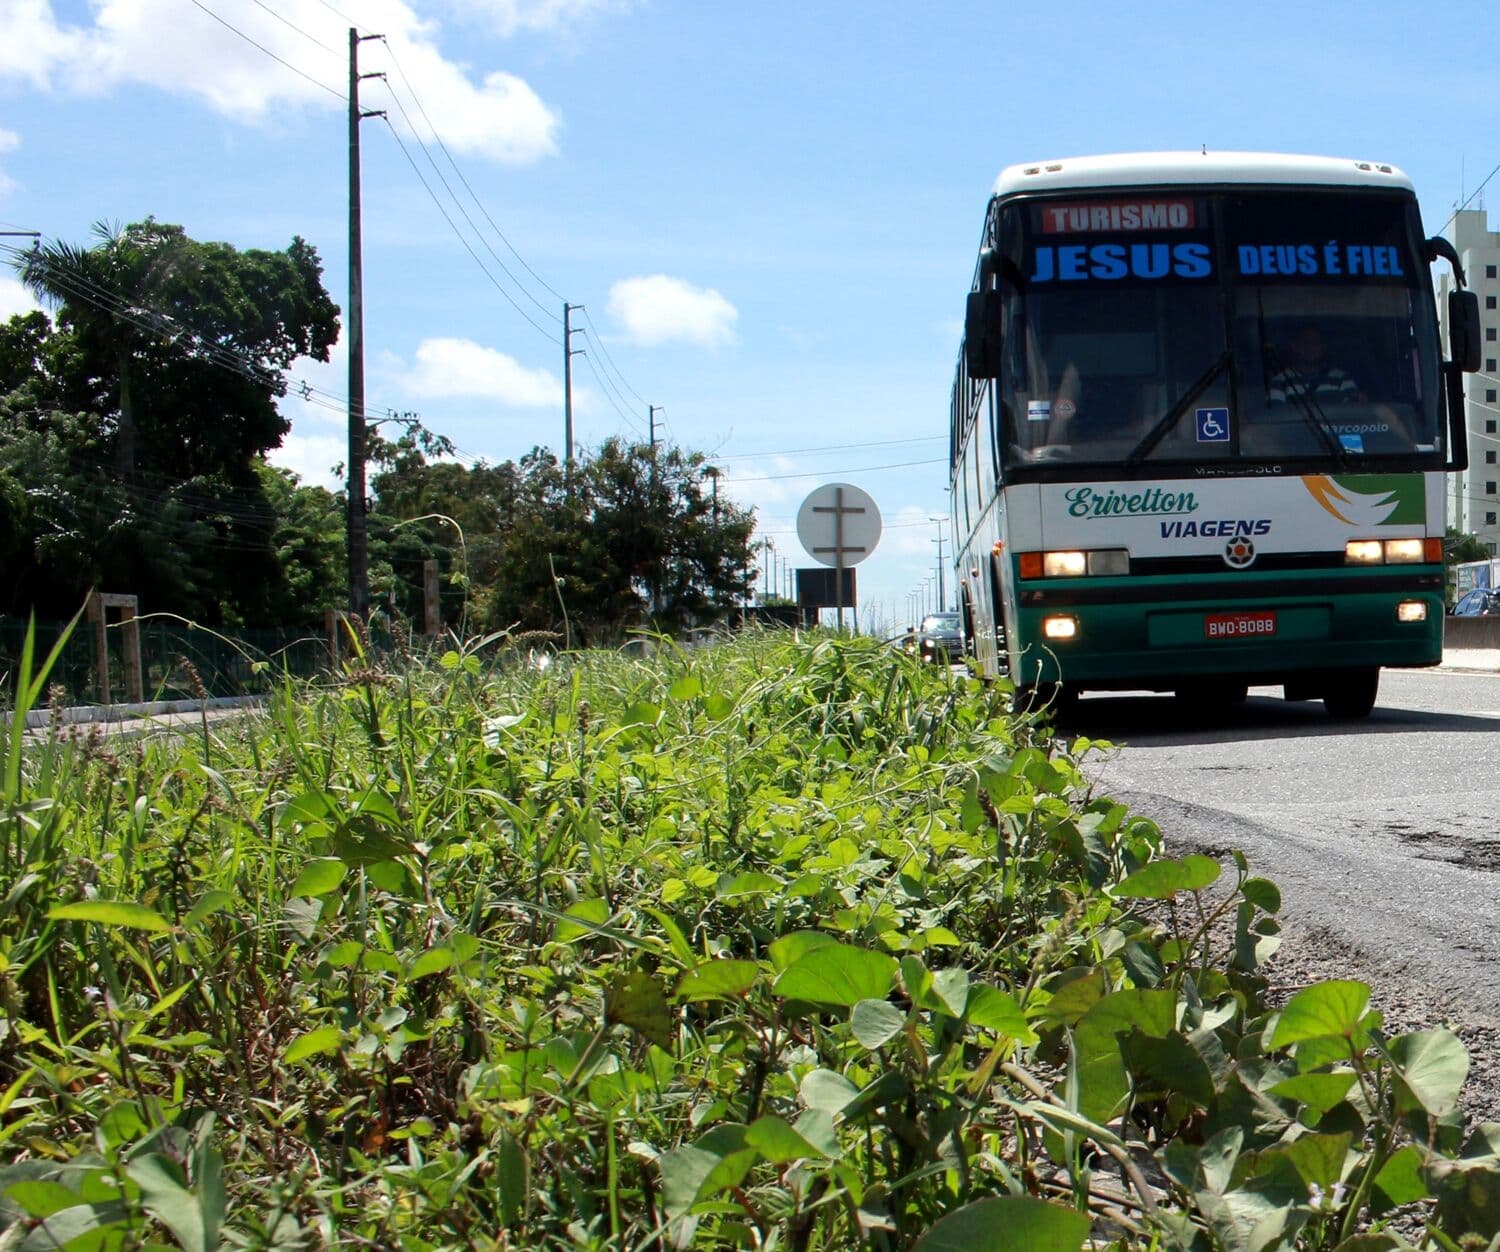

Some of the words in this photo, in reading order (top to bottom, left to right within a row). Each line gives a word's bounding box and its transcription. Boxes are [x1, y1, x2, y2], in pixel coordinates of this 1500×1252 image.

[1050, 203, 1188, 233] TURISMO
[1031, 243, 1212, 282] JESUS
[1237, 244, 1318, 275] DEUS
[1323, 240, 1342, 275] É
[1346, 245, 1404, 276] FIEL
[1065, 487, 1199, 520] Erivelton
[1160, 519, 1272, 538] VIAGENS
